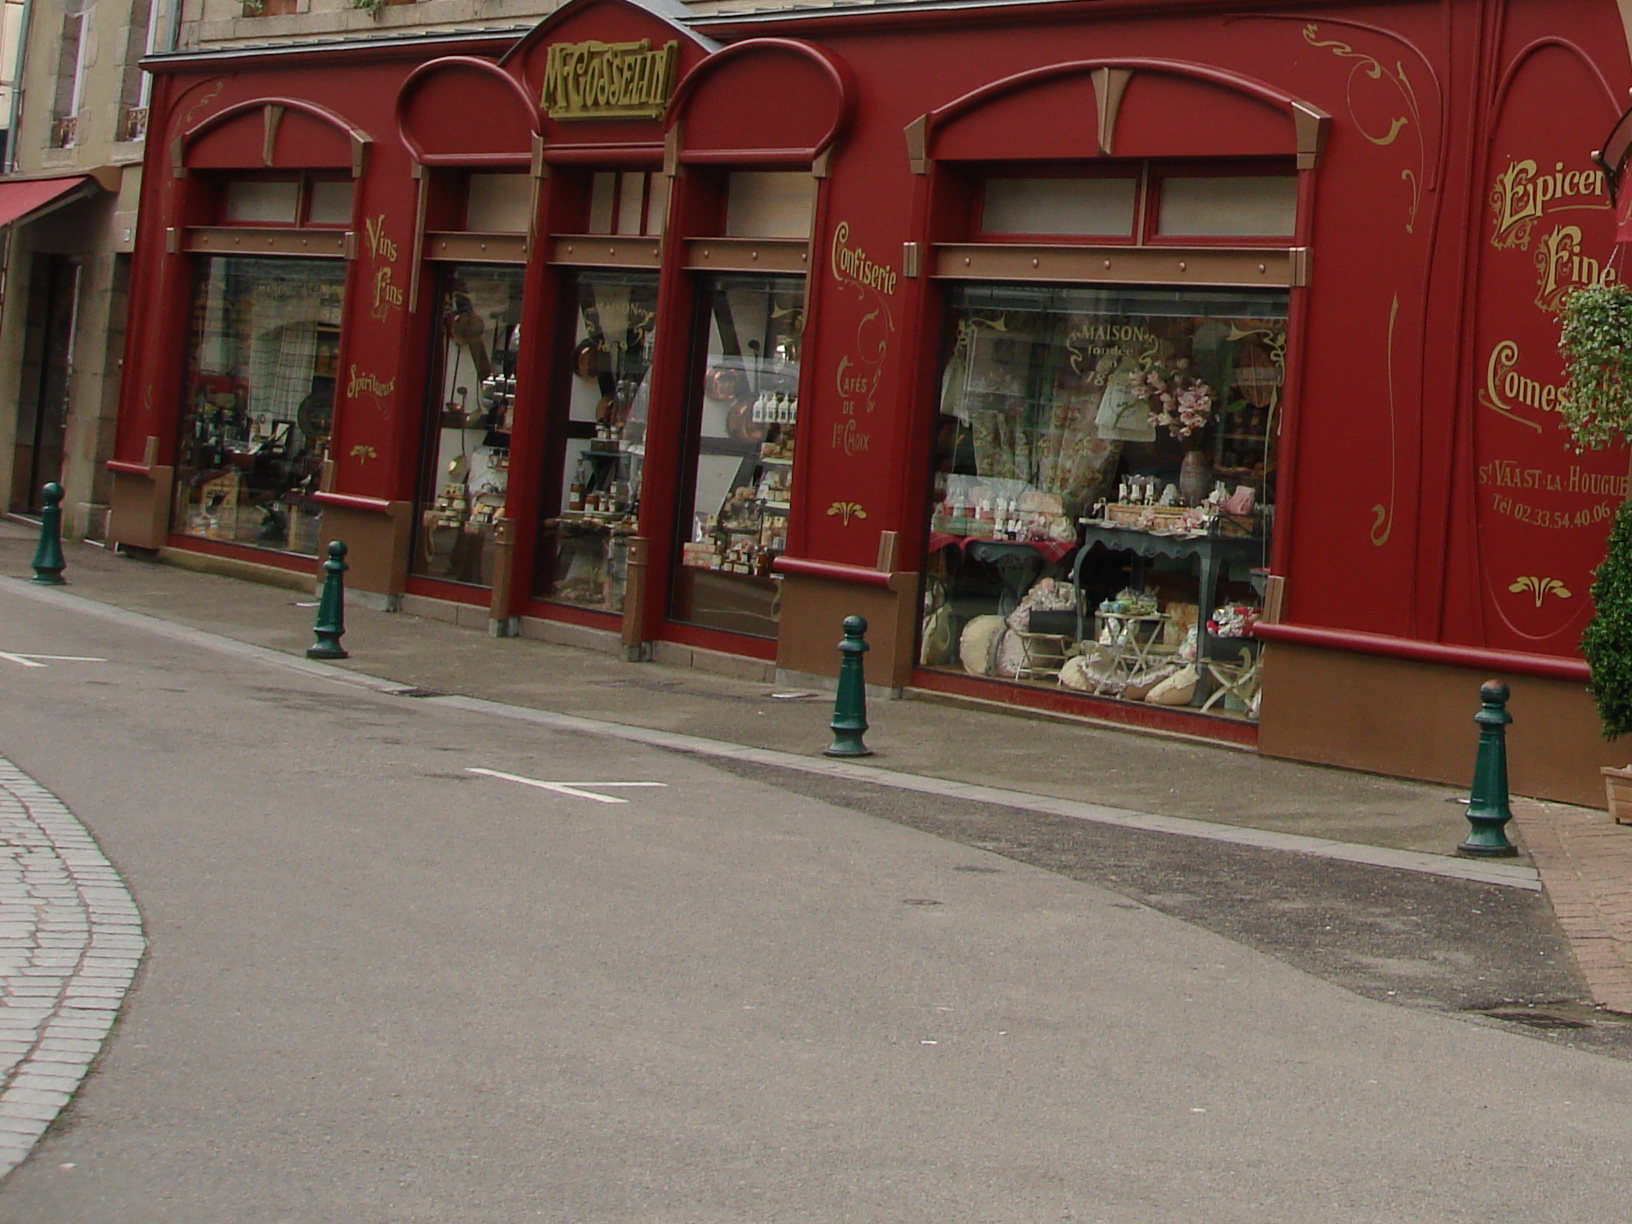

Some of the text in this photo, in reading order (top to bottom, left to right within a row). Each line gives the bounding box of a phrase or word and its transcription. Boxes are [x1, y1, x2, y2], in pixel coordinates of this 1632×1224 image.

[1491, 160, 1606, 244] Epicer
[366, 214, 397, 262] Vins
[831, 220, 897, 296] Confiserie
[1538, 225, 1616, 302] Fine
[374, 267, 403, 313] Fins
[1081, 325, 1144, 342] MAISON
[1493, 494, 1512, 516] Tél
